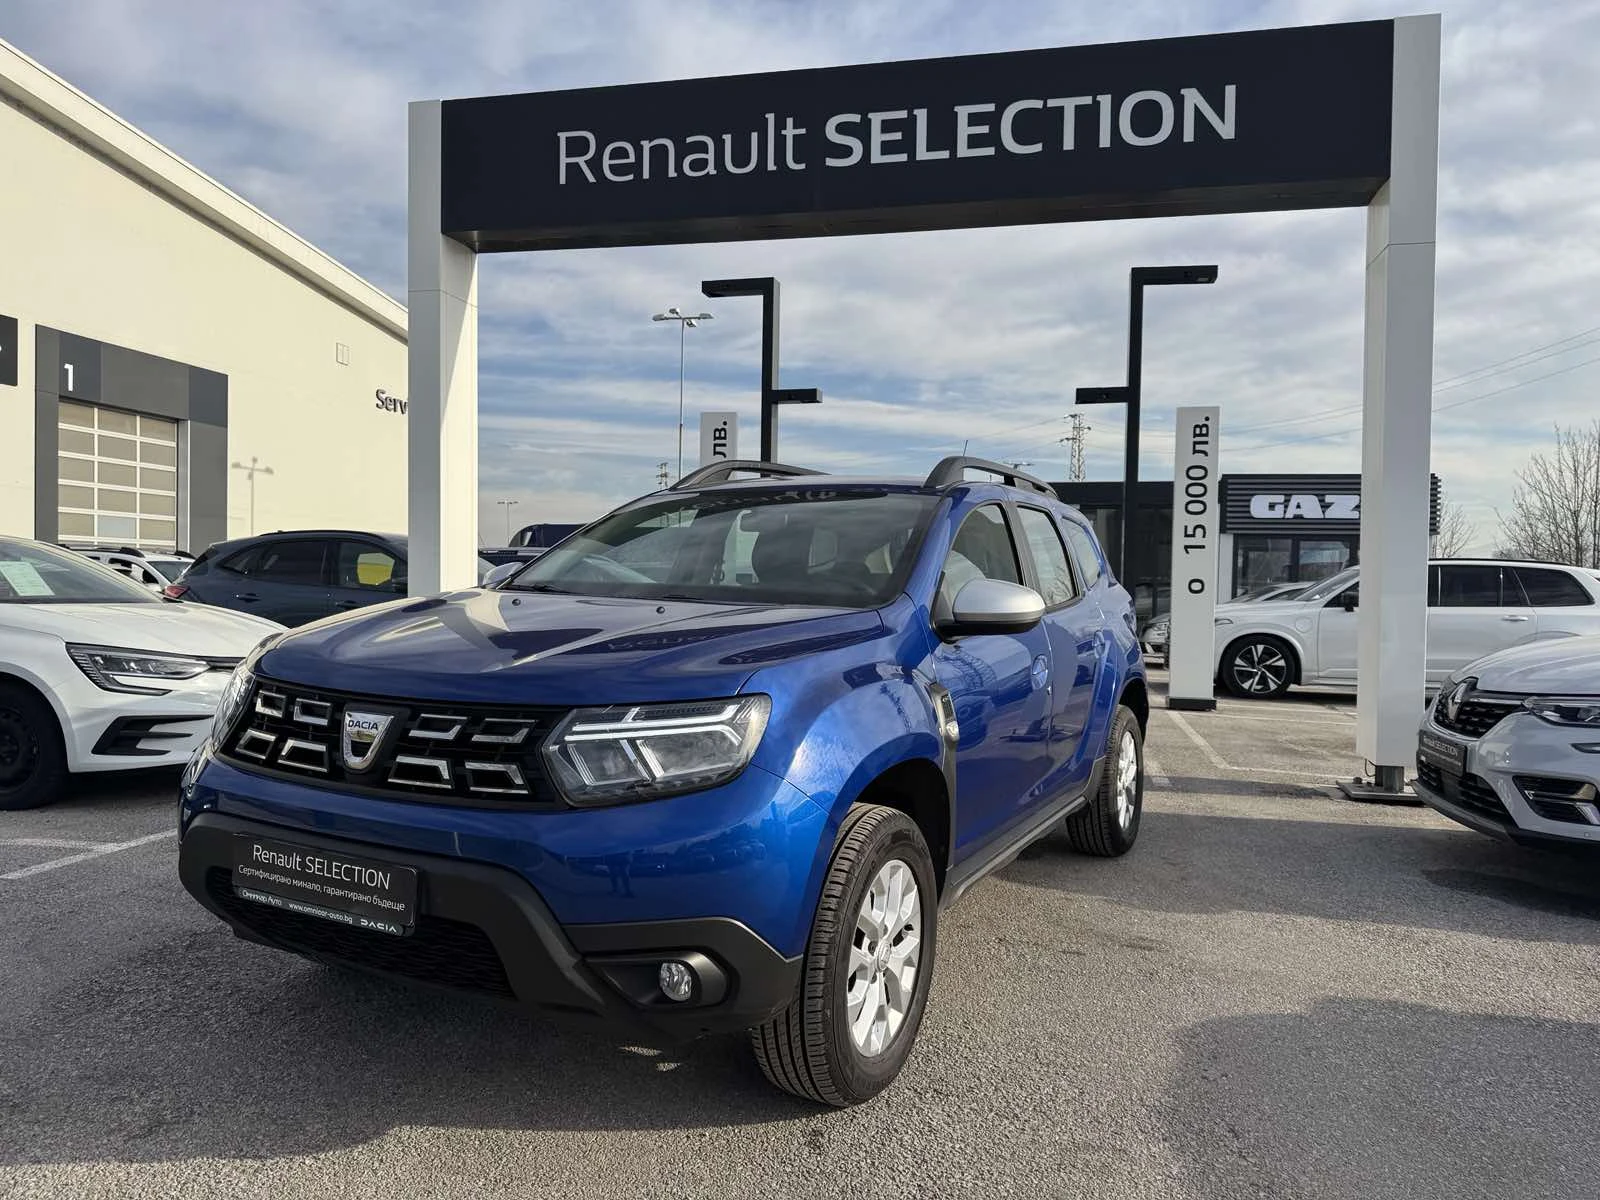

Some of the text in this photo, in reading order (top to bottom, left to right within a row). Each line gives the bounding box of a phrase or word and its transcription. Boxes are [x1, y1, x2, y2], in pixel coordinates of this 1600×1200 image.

[557, 84, 1237, 185] Renault SELECTION
[64, 363, 74, 392] 1
[1250, 494, 1360, 519] GAZ
[348, 719, 379, 731] DACIA
[253, 844, 391, 890] Renault SELECTION
[238, 864, 292, 885] Сертифицирано
[323, 886, 372, 903] гарантирано
[372, 896, 405, 912] бъдеще
[360, 918, 397, 933] DACIA
